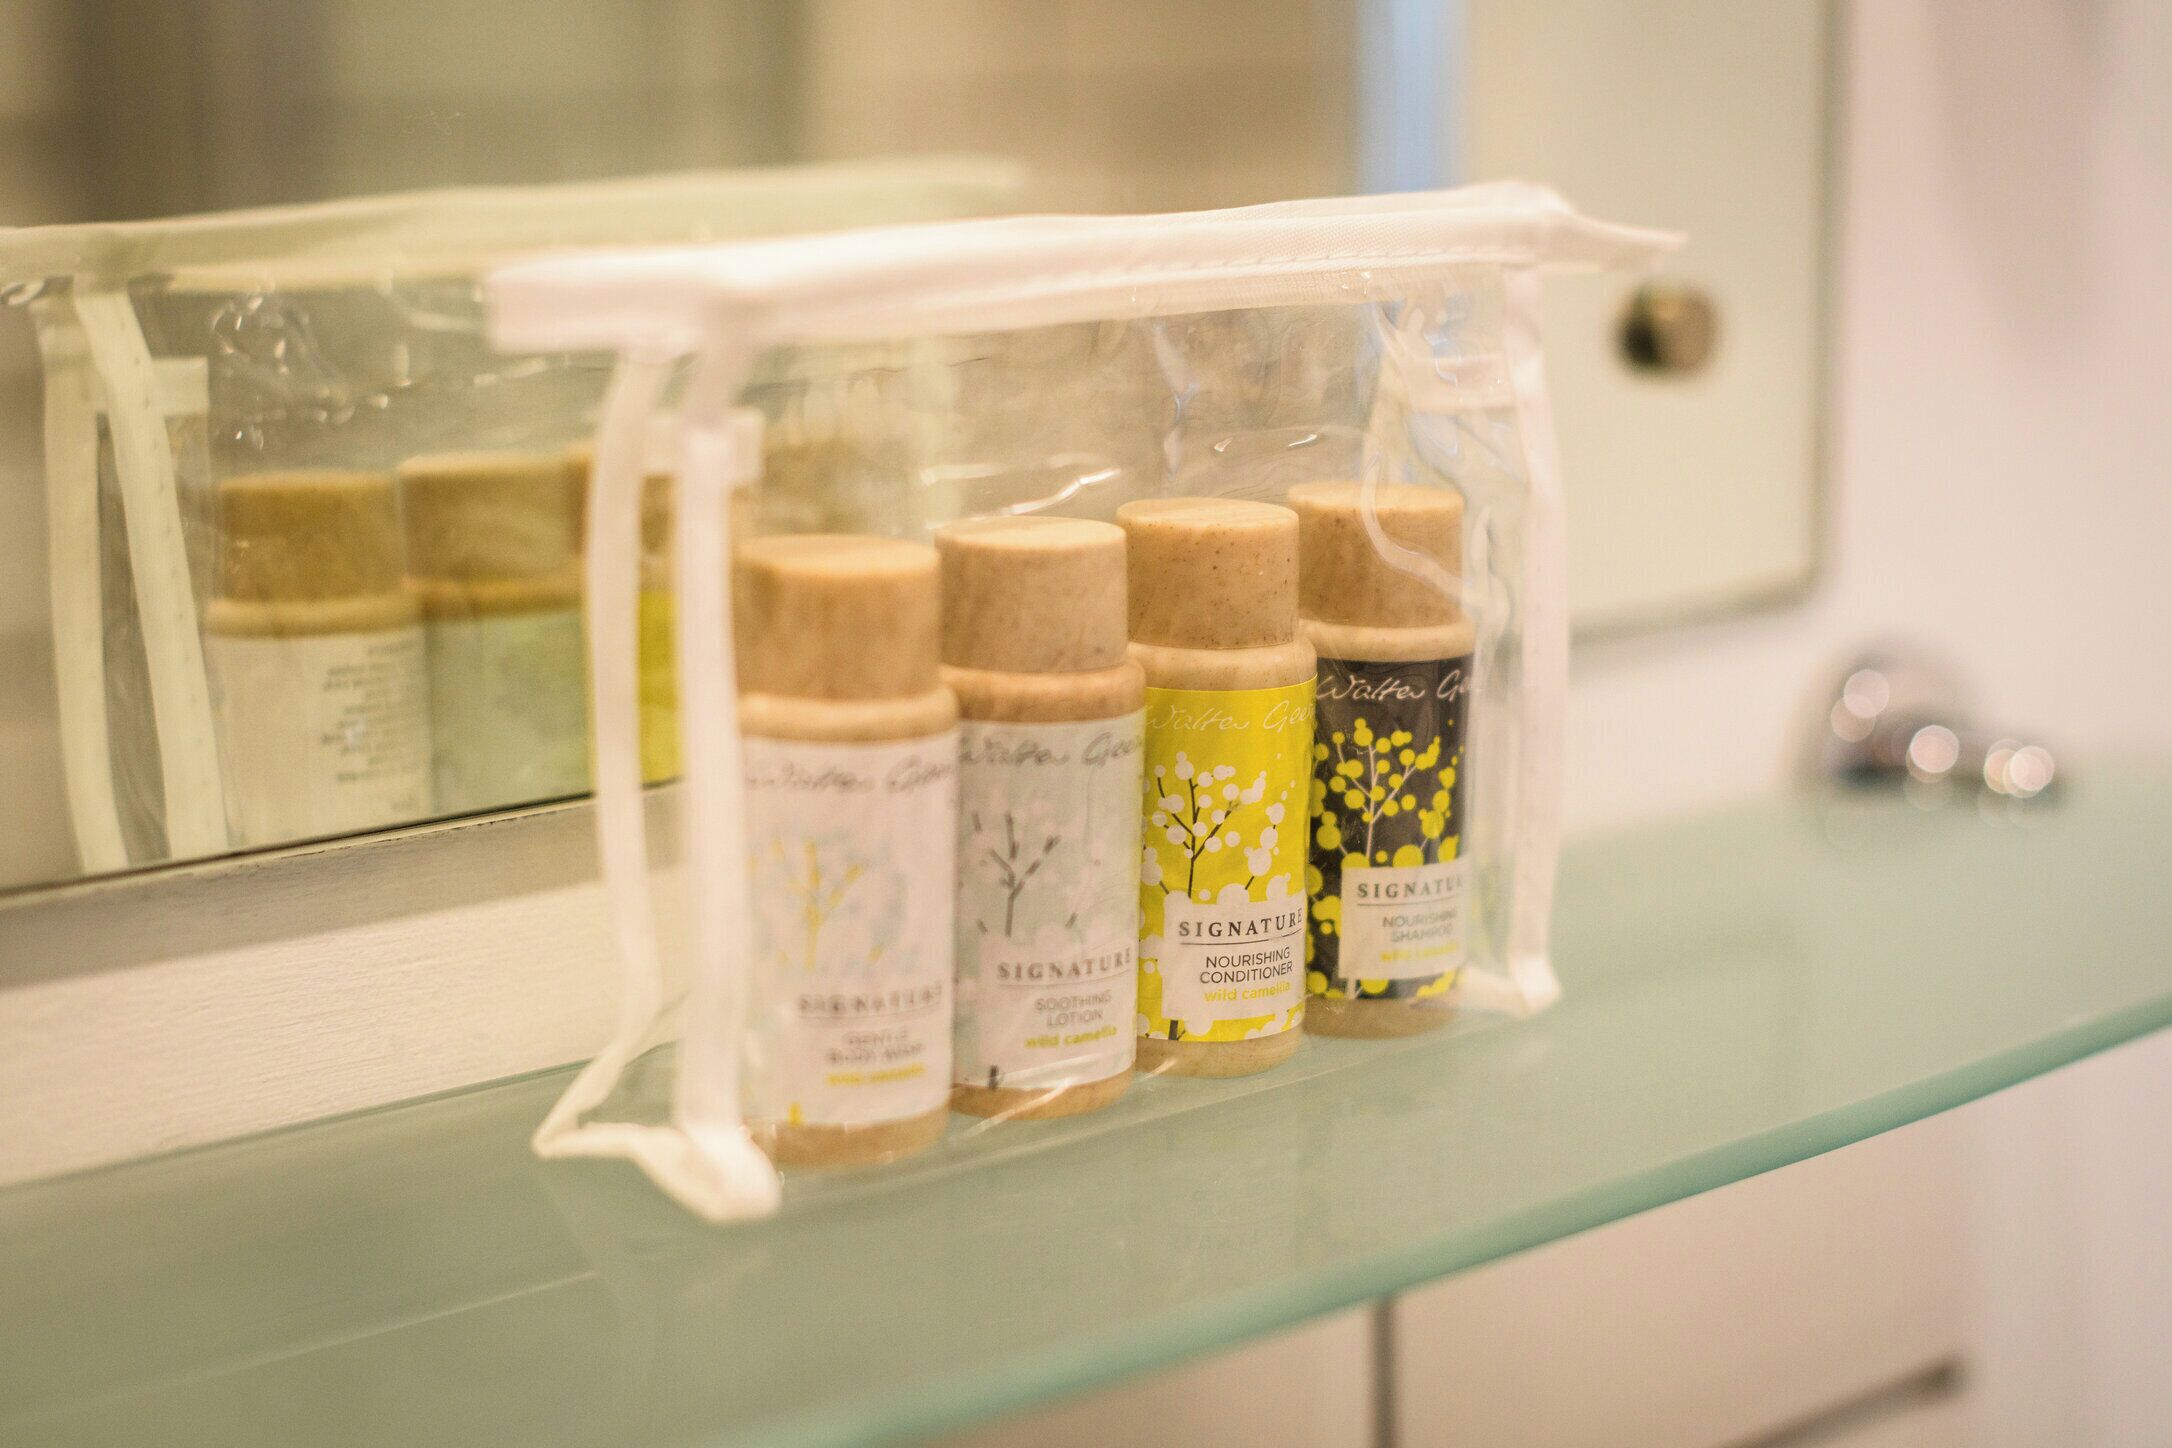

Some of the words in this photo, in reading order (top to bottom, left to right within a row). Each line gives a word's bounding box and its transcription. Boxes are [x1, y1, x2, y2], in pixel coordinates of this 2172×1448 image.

[1178, 907, 1303, 938] SIGNATURE
[997, 947, 1131, 981] SIGNATURE
[1205, 946, 1291, 969] NOURISHING
[1199, 961, 1293, 984] CONDITIONER
[1034, 989, 1113, 1013] SOOTHING
[1203, 987, 1237, 1002] wild
[1241, 980, 1292, 1001] camellia
[1046, 1009, 1104, 1029] LOTION
